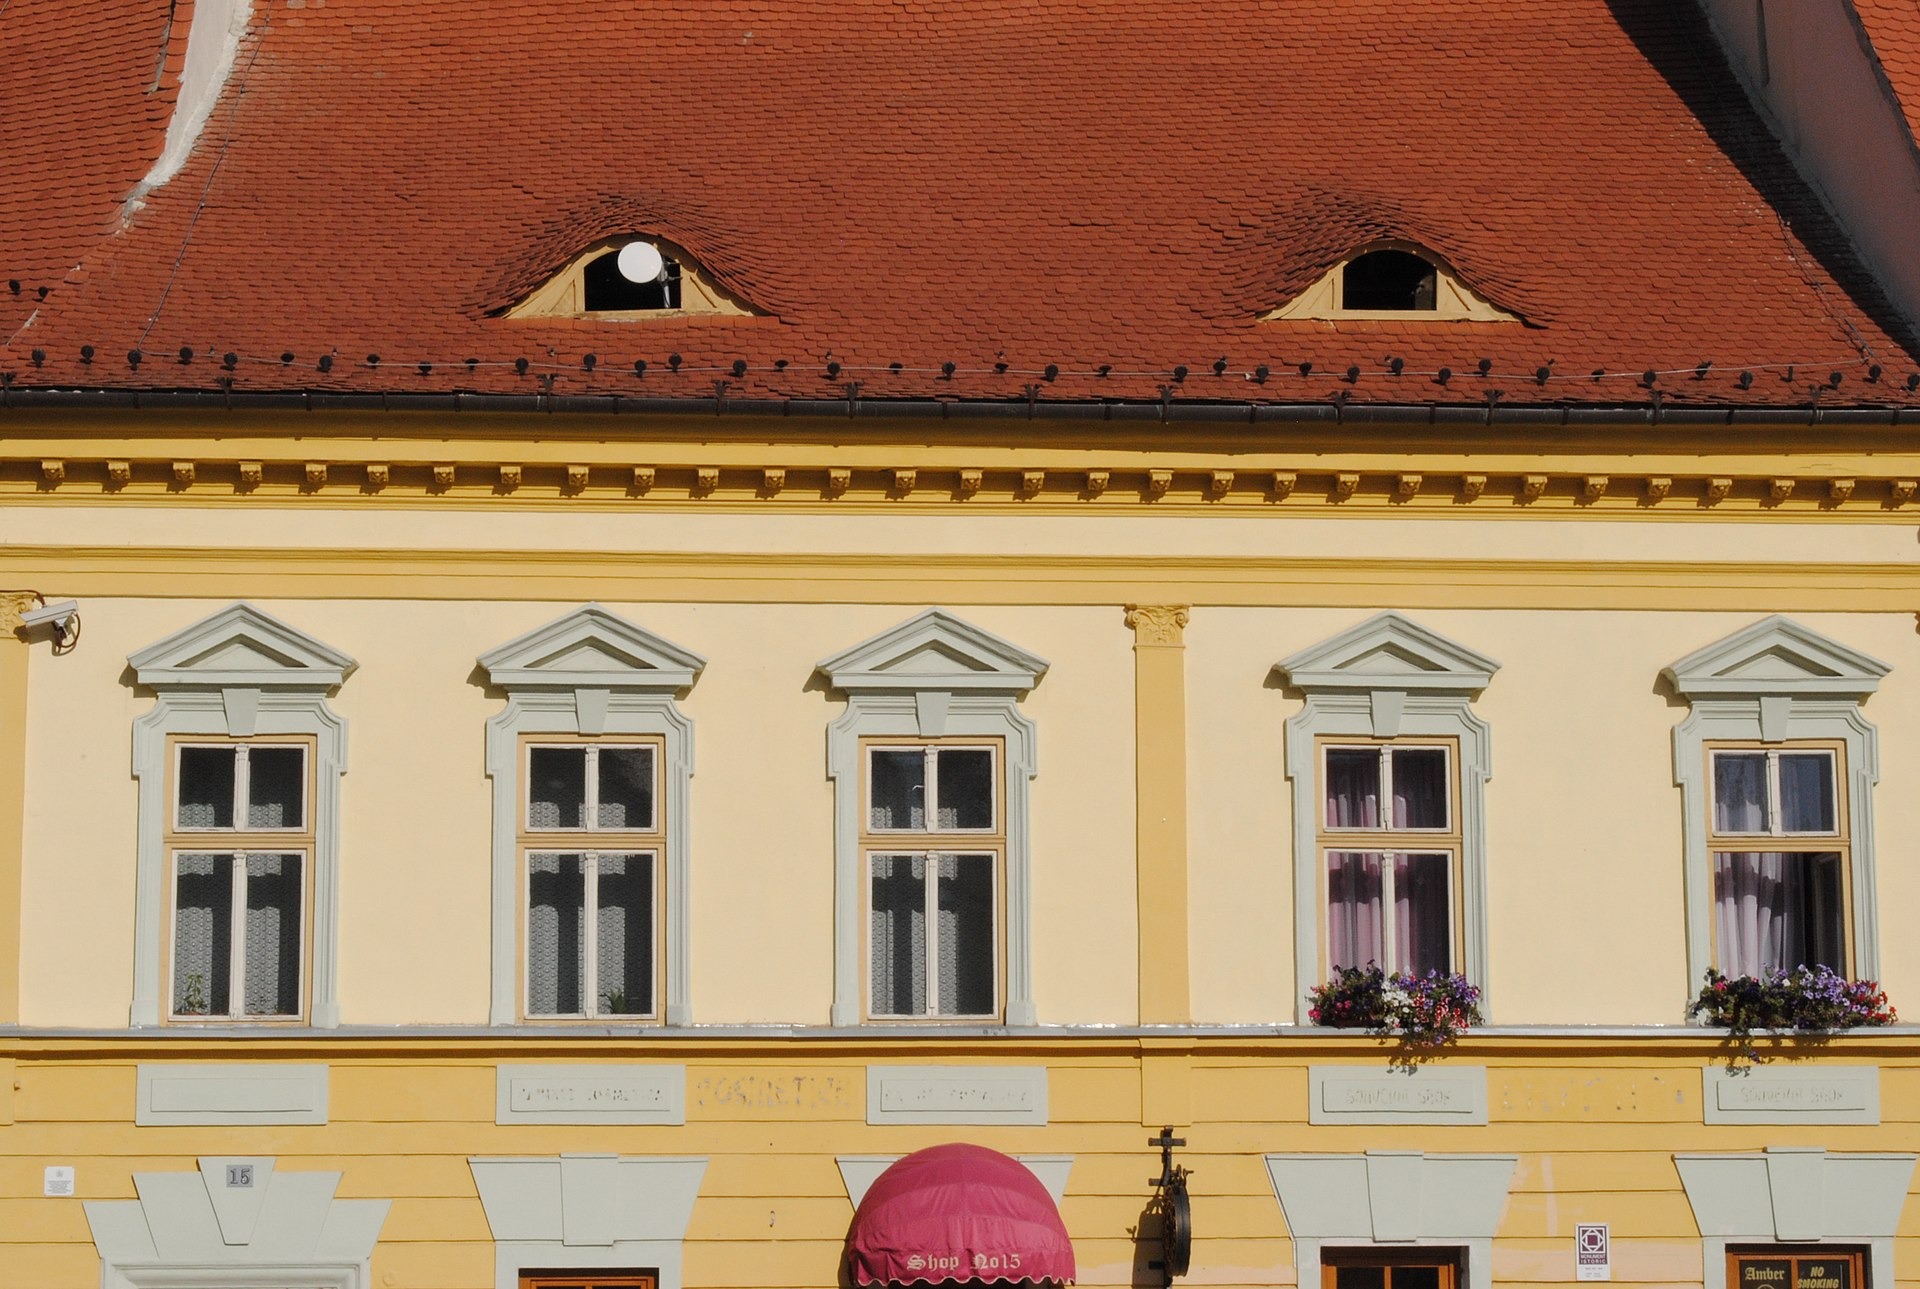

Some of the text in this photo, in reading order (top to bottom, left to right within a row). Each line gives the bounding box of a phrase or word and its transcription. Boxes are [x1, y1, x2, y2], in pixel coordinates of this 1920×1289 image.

[230, 1168, 250, 1185] 15
[906, 1253, 959, 1272] Shop
[1744, 1266, 1785, 1281] Amber
[1810, 1266, 1825, 1278] NO
[1797, 1278, 1840, 1289] SMOKING
